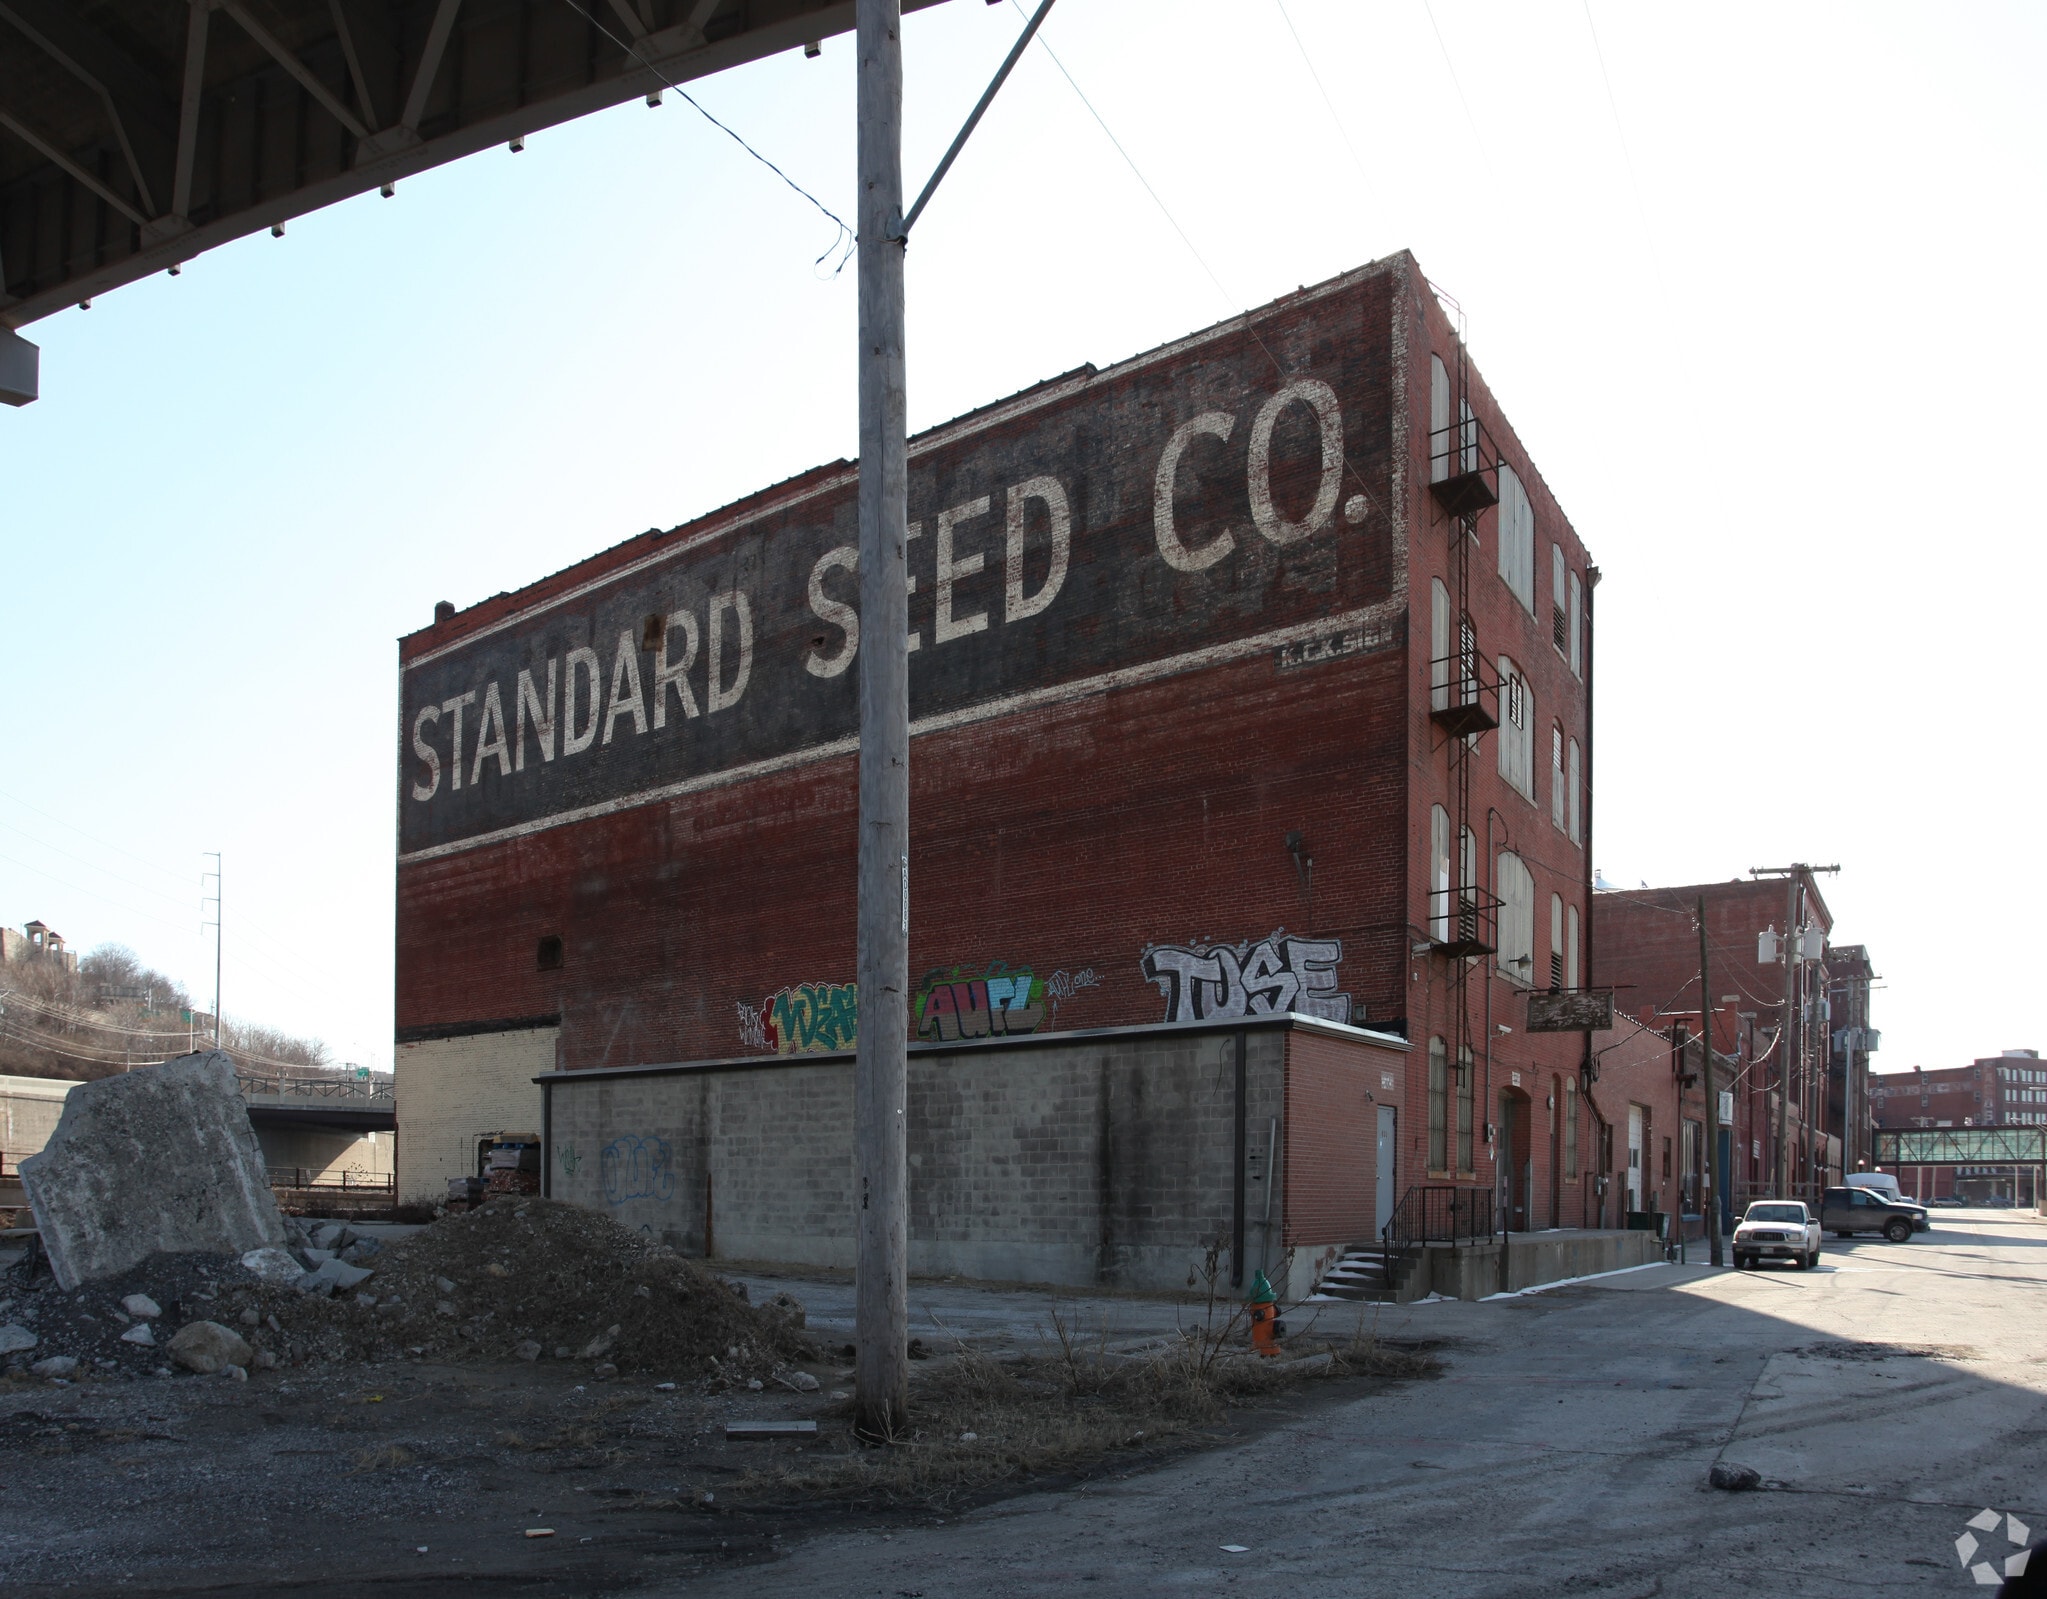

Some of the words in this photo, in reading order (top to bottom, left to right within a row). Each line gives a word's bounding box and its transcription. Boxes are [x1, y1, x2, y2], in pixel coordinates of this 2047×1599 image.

[411, 590, 753, 802] STANDARD
[805, 474, 1071, 679] SED
[1153, 378, 1370, 572] CO.
